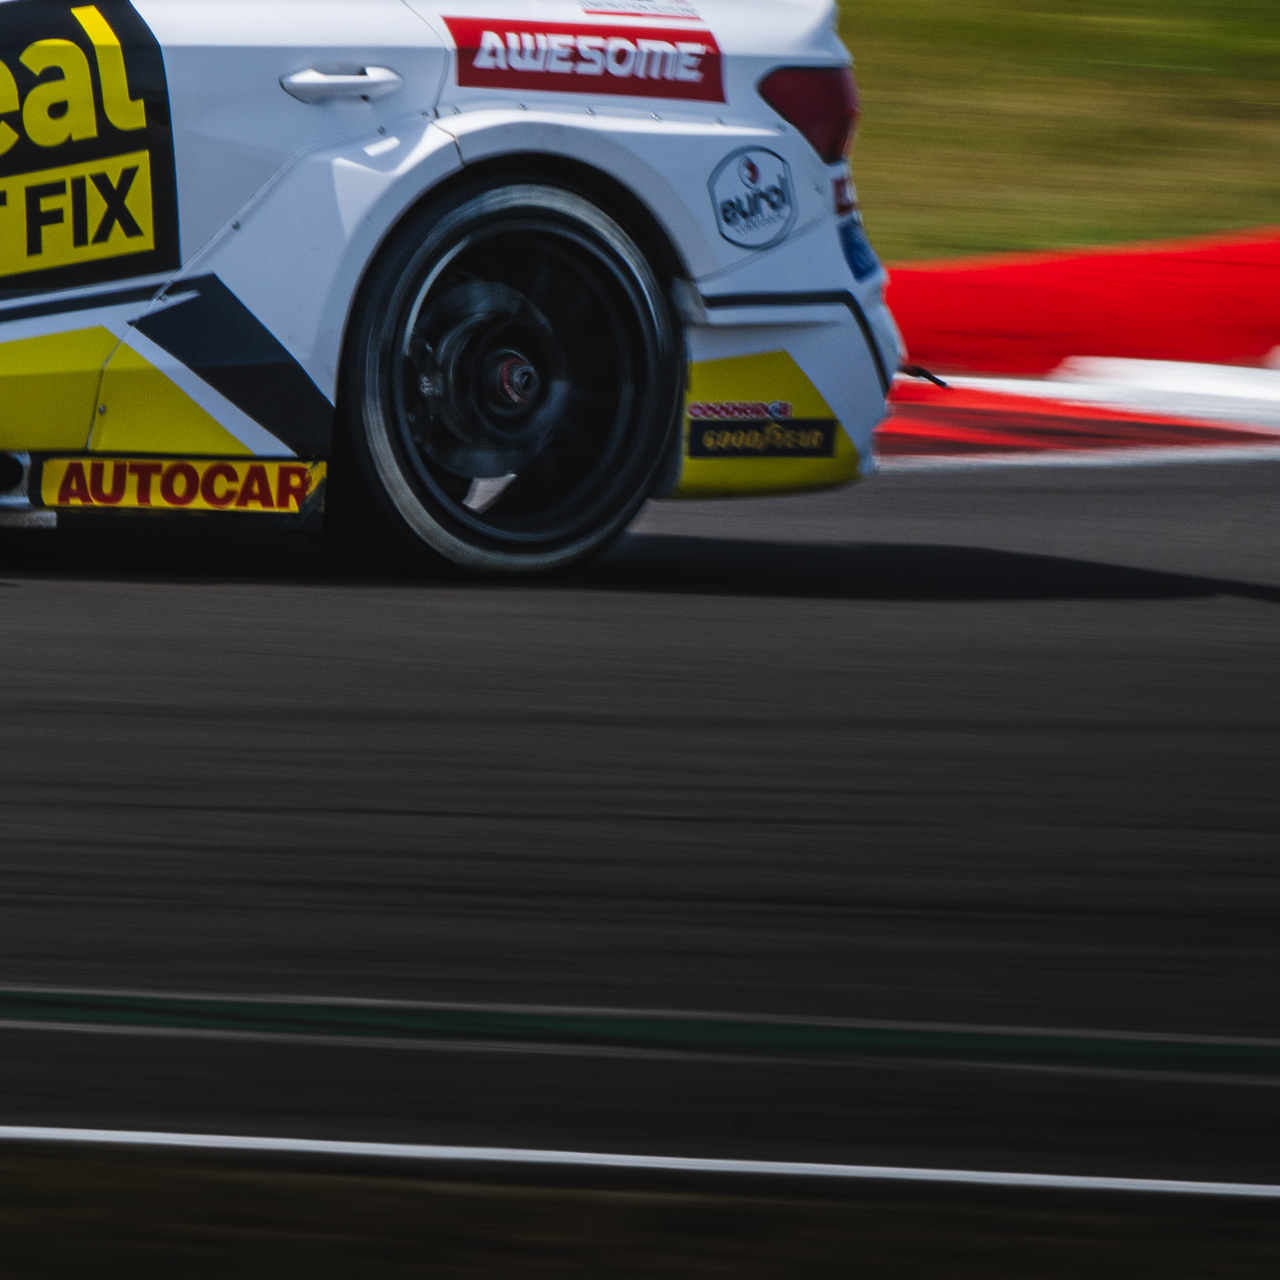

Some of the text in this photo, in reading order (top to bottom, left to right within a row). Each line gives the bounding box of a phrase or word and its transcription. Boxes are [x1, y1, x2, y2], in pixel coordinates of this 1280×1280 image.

[473, 30, 707, 83] AWESOME
[25, 164, 144, 257] FIX
[57, 461, 311, 510] AUTOCAR
